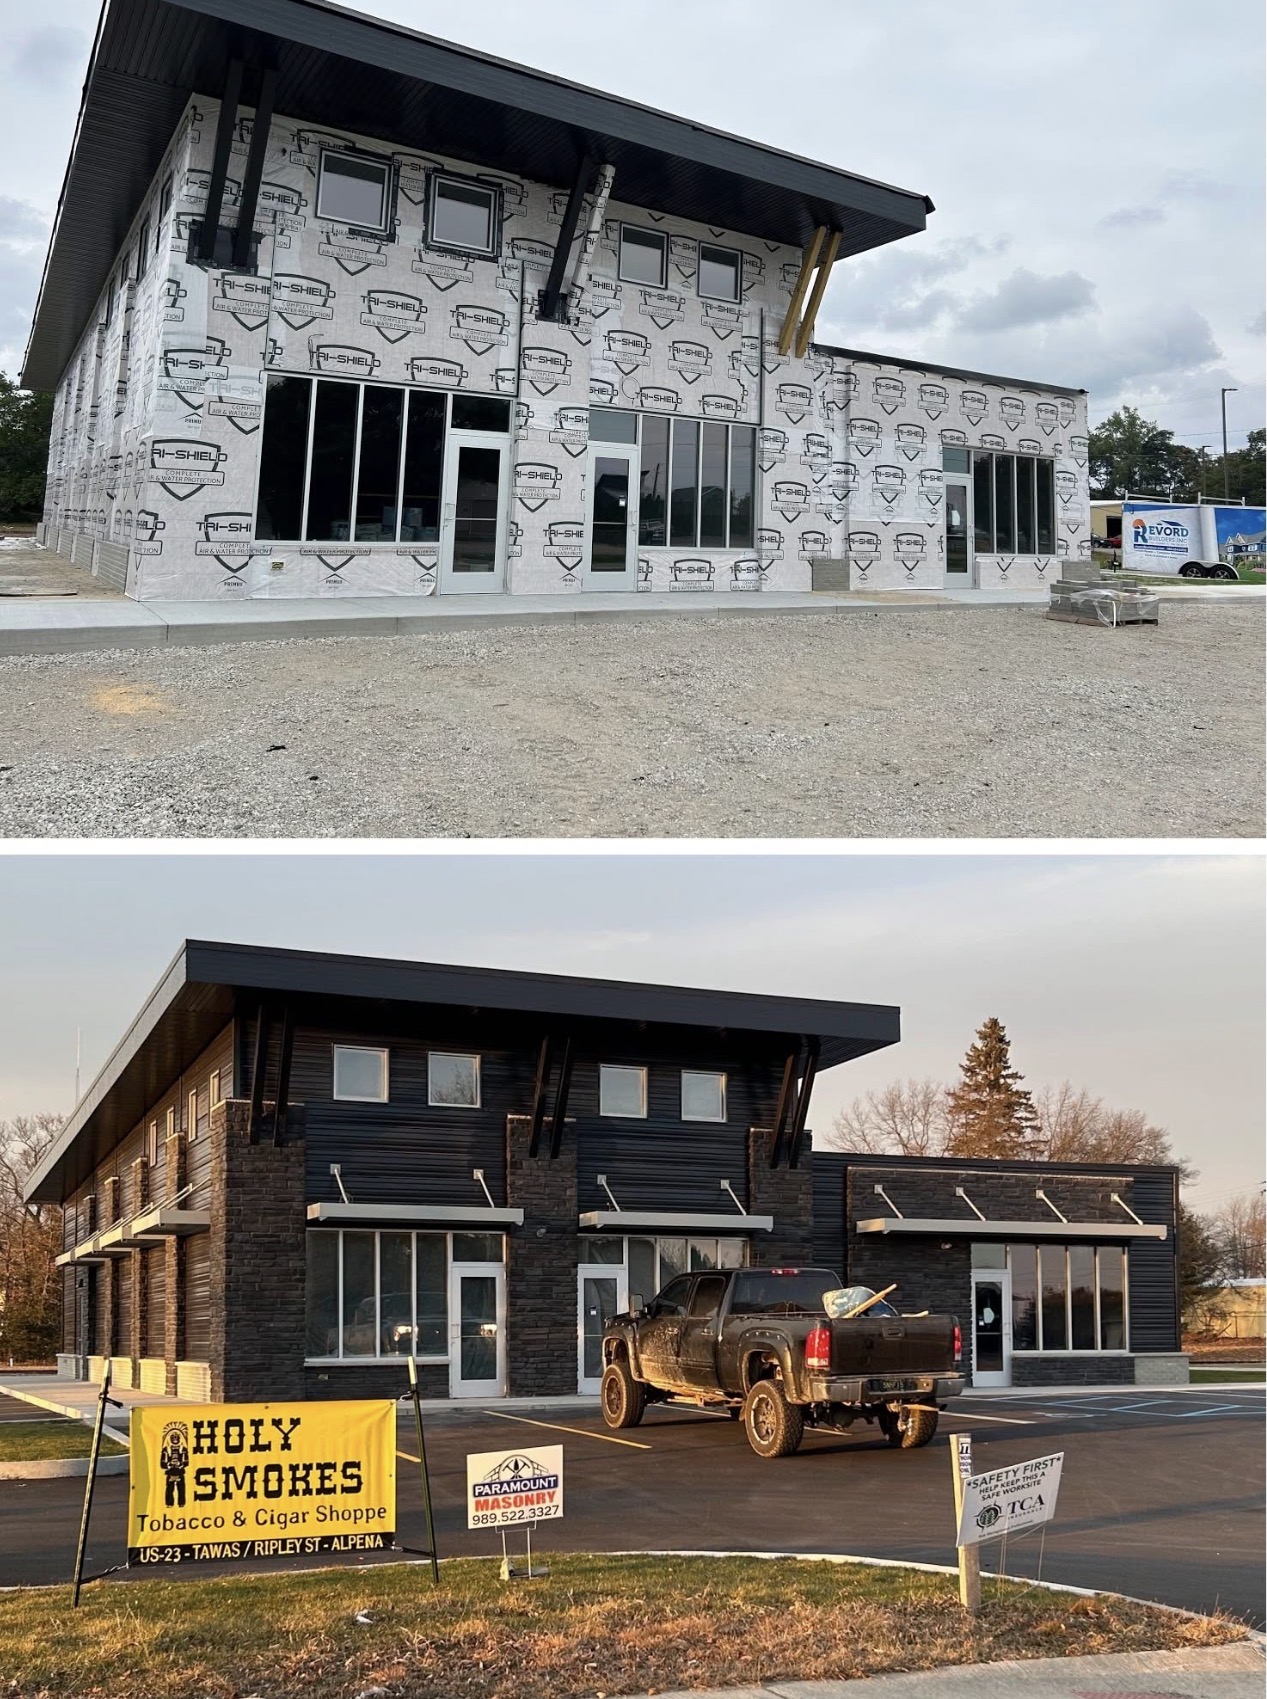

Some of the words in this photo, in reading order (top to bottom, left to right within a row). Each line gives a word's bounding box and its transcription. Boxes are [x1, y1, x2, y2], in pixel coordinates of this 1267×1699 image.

[262, 191, 308, 207] SHIELD
[506, 241, 554, 259] TRI-SHIEL
[213, 278, 271, 295] TRI-SHIE
[273, 281, 336, 299] RI-SHIELD
[592, 280, 623, 292] SHIELD
[361, 295, 428, 314] TRI-SHIELD
[450, 310, 510, 327] TRI-SHIELD
[602, 335, 652, 349] TRI-SHIELD
[310, 350, 381, 367] TRI-SHIELD
[520, 353, 573, 367] RI-SHIELD
[404, 363, 468, 379] TRI-SHIELD
[589, 387, 619, 397] SHIELD
[775, 388, 813, 399] TRI-SHIEL
[150, 448, 228, 462] RI-SHIELD
[183, 477, 221, 485] PROTECTION
[514, 471, 562, 481] RI-SHIELD
[196, 522, 251, 532] TRI-SHI
[543, 529, 584, 538] TRI-SHIE
[669, 566, 716, 574] TRI-SHIELD
[192, 1417, 301, 1454] HOLY
[193, 1460, 364, 1502] SMOKES
[972, 1468, 1020, 1489] SAFETY
[1023, 1458, 1056, 1474] FIRST
[474, 1477, 557, 1496] PARAMOUNT
[980, 1483, 999, 1495] HELP
[1000, 1478, 1021, 1489] KEEP
[1022, 1473, 1039, 1482] THIS
[981, 1490, 1001, 1501] SAFE
[1002, 1479, 1042, 1495] WORKSITE
[474, 1490, 557, 1512] MASONRY
[1007, 1494, 1046, 1515] TCA
[136, 1513, 225, 1532] Tobacco
[232, 1510, 247, 1527] &
[255, 1508, 309, 1530] Cigar
[316, 1504, 387, 1525] Shoppe
[472, 1504, 560, 1525] 989.522.3327
[140, 1547, 181, 1563] US-23
[192, 1542, 241, 1560] TAWAS
[254, 1538, 303, 1556] RIPLEY
[304, 1537, 321, 1553] ST
[331, 1534, 384, 1551] ALPENA
